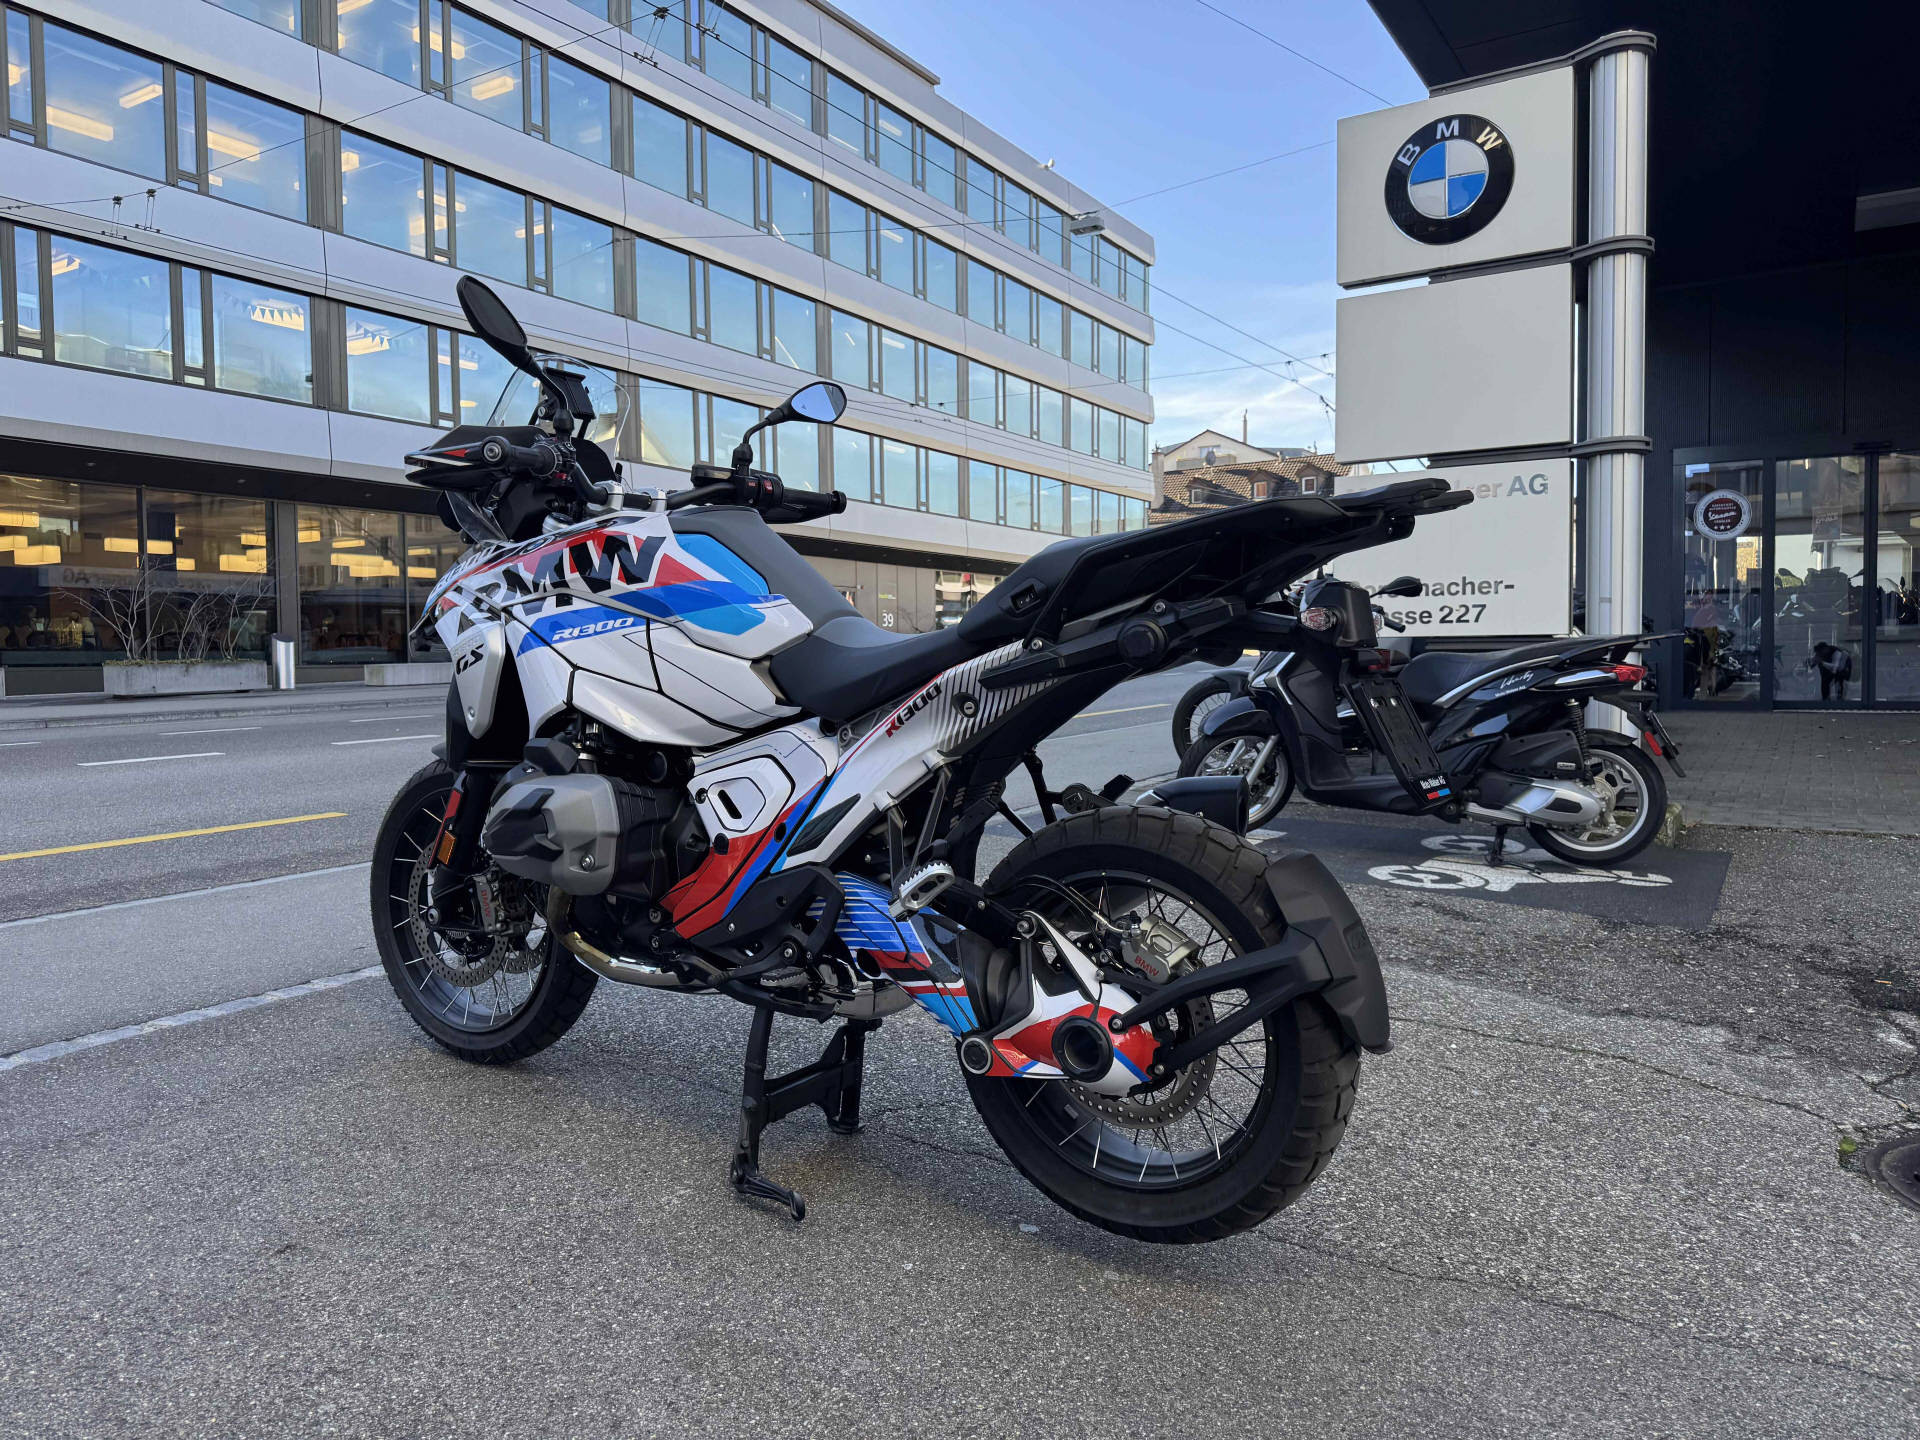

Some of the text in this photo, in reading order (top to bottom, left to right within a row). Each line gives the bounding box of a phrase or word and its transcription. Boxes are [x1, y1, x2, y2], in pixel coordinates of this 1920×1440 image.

[1397, 119, 1503, 166] BMW
[1506, 473, 1549, 496] AG
[882, 613, 894, 627] 39
[1439, 604, 1487, 624] 227
[552, 617, 634, 641] R1300
[456, 643, 484, 675] GS
[885, 682, 942, 738] R1300
[1134, 955, 1160, 976] BMW
